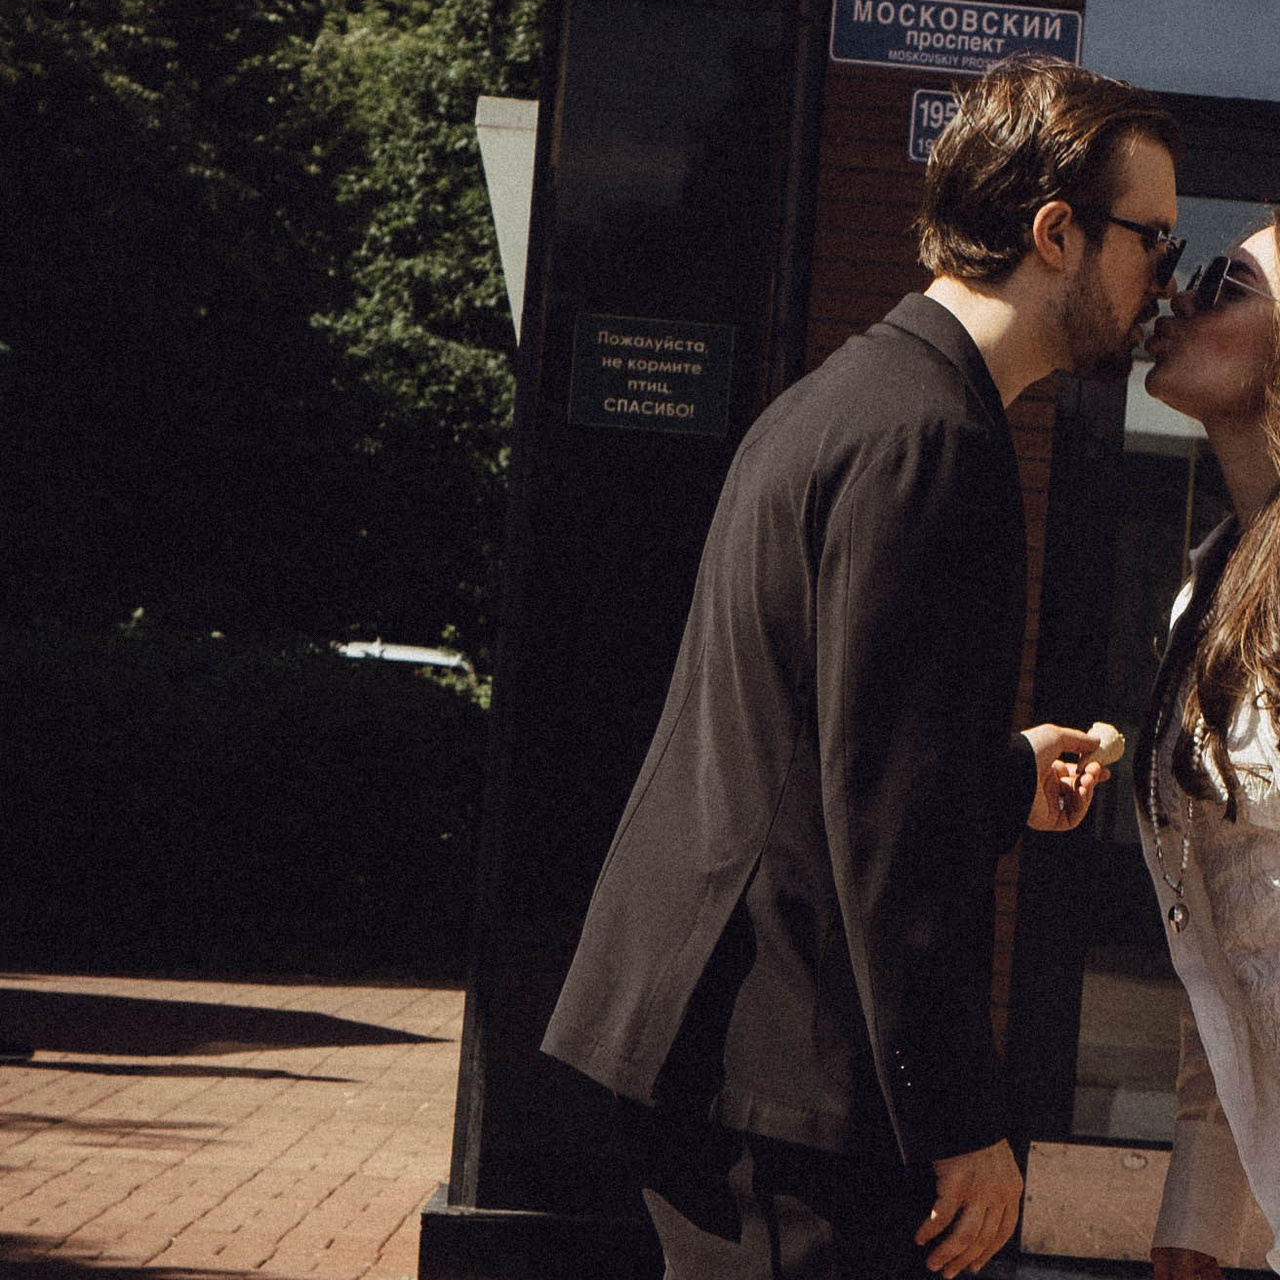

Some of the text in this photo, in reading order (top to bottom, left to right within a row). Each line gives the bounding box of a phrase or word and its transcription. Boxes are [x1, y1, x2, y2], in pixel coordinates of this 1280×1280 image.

[905, 29, 1006, 54] проспект
[888, 49, 960, 66] MOSKOVSKIY
[597, 330, 709, 354] Пожалуйста,
[601, 356, 703, 376] не кормите
[627, 379, 672, 395] птиц.
[603, 397, 695, 419] СПАСИБО!
